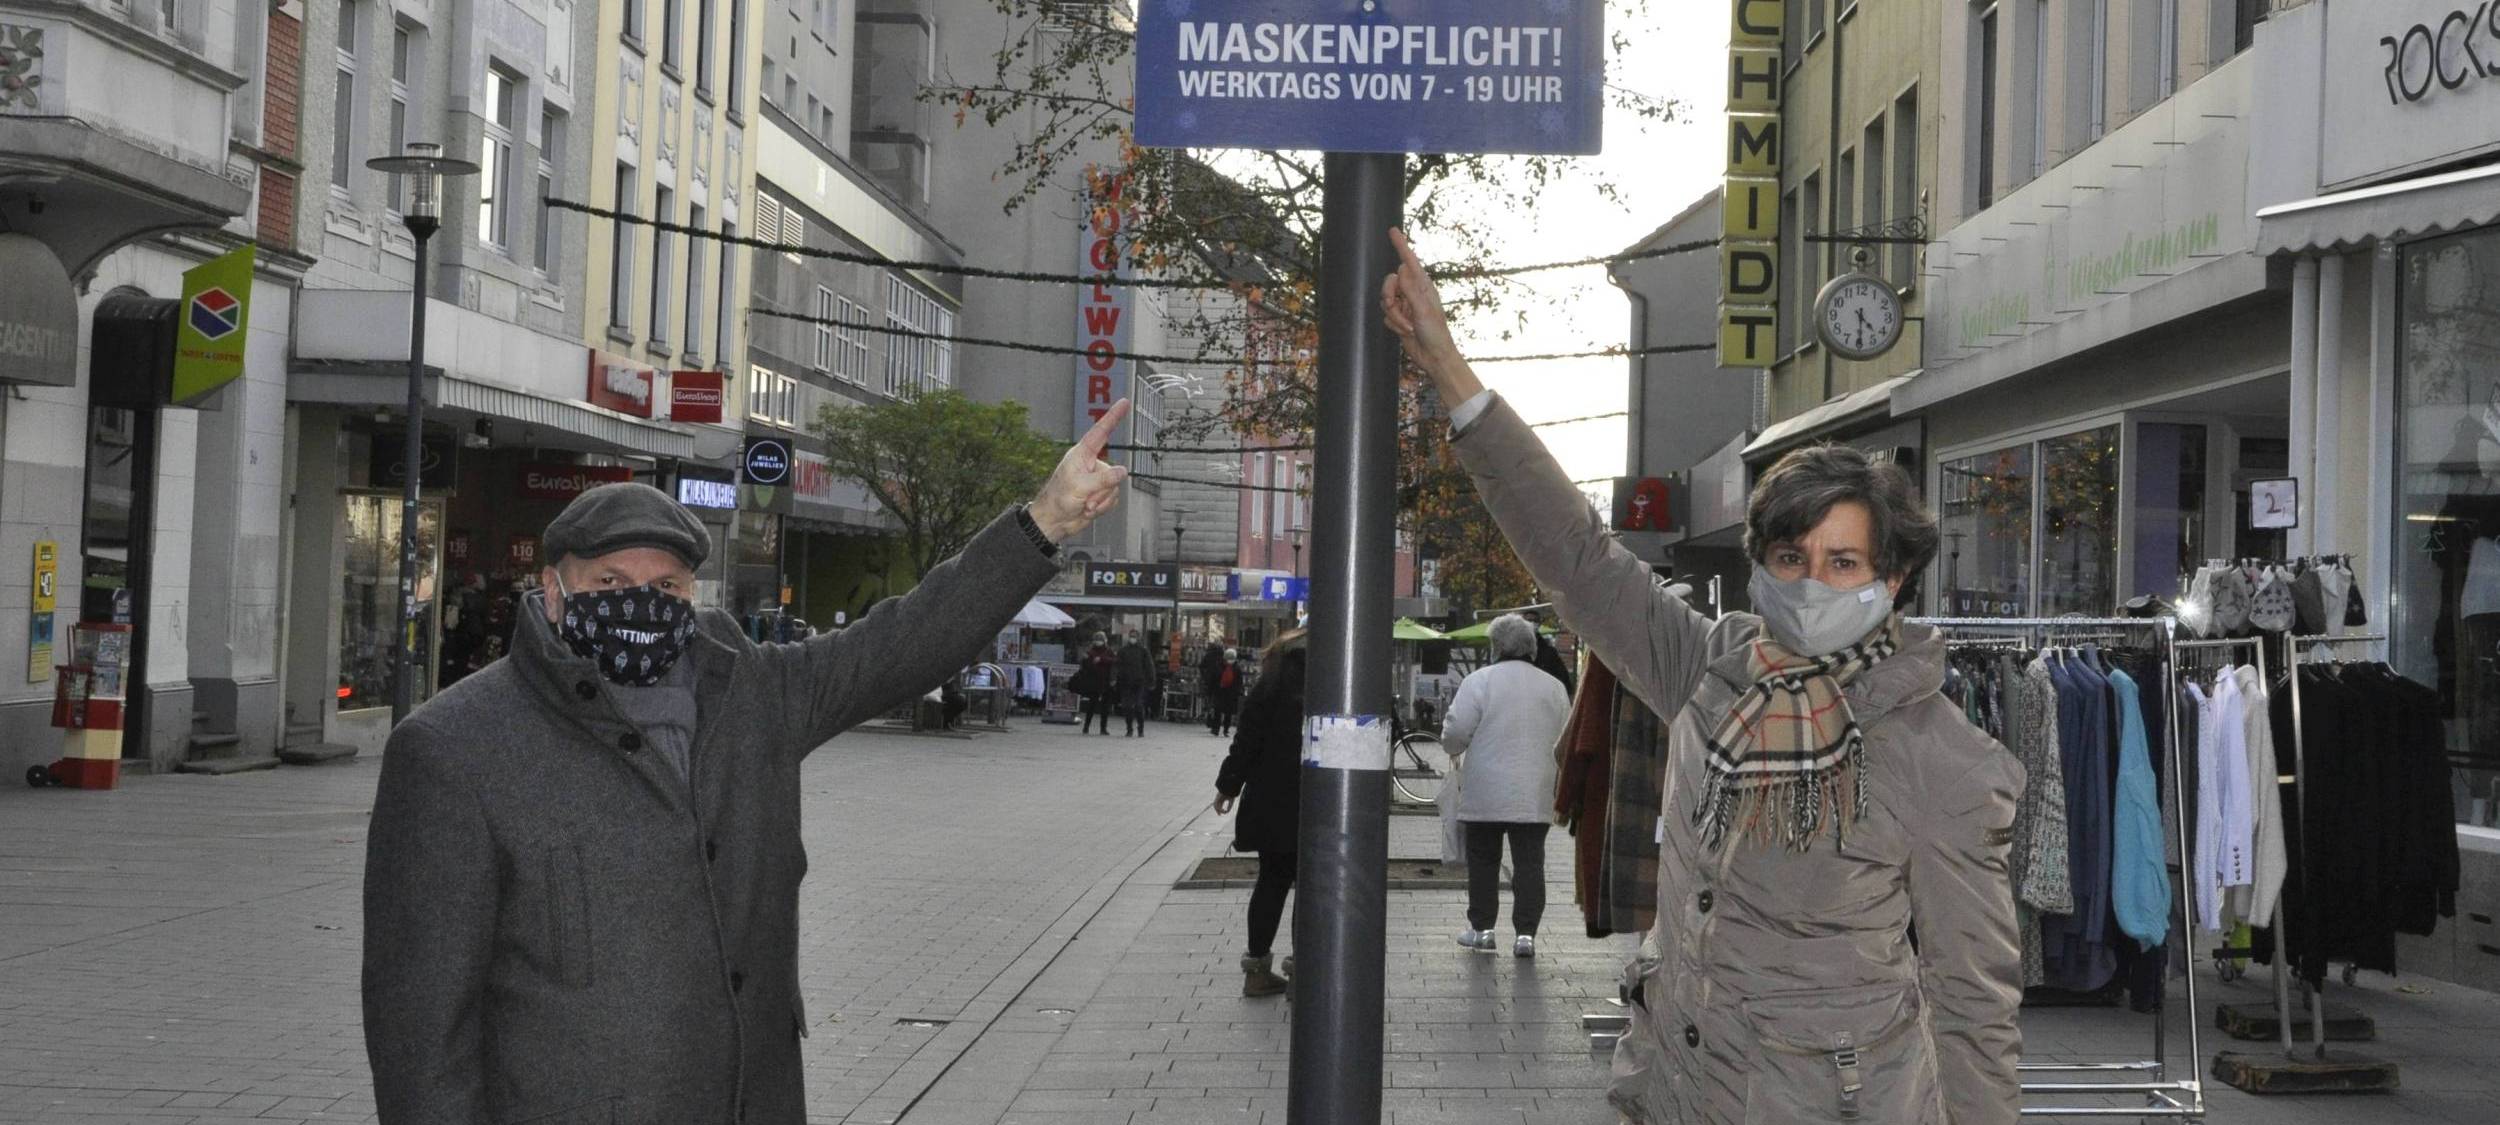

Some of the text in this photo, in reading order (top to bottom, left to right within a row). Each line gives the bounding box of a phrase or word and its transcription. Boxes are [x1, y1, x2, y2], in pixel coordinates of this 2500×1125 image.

[1178, 21, 1563, 67] MASKENPFLICHT!
[1178, 70, 1342, 101] WERKTAGS
[1350, 73, 1413, 102] VON
[1421, 75, 1437, 101] 7
[1463, 75, 1494, 102] 19
[1502, 75, 1563, 103] UHR
[1856, 285, 1868, 296] 12
[1834, 296, 1844, 308] 10
[1880, 297, 1889, 310] 2
[1829, 308, 1838, 321] 9
[1884, 311, 1892, 324] 3
[1833, 322, 1841, 335] 8
[1878, 325, 1887, 336] 4
[1843, 332, 1852, 344] 7
[1869, 333, 1877, 346] 5
[527, 472, 617, 490] EuroSho
[511, 544, 534, 557] 1.10
[1092, 570, 1128, 585] FOR
